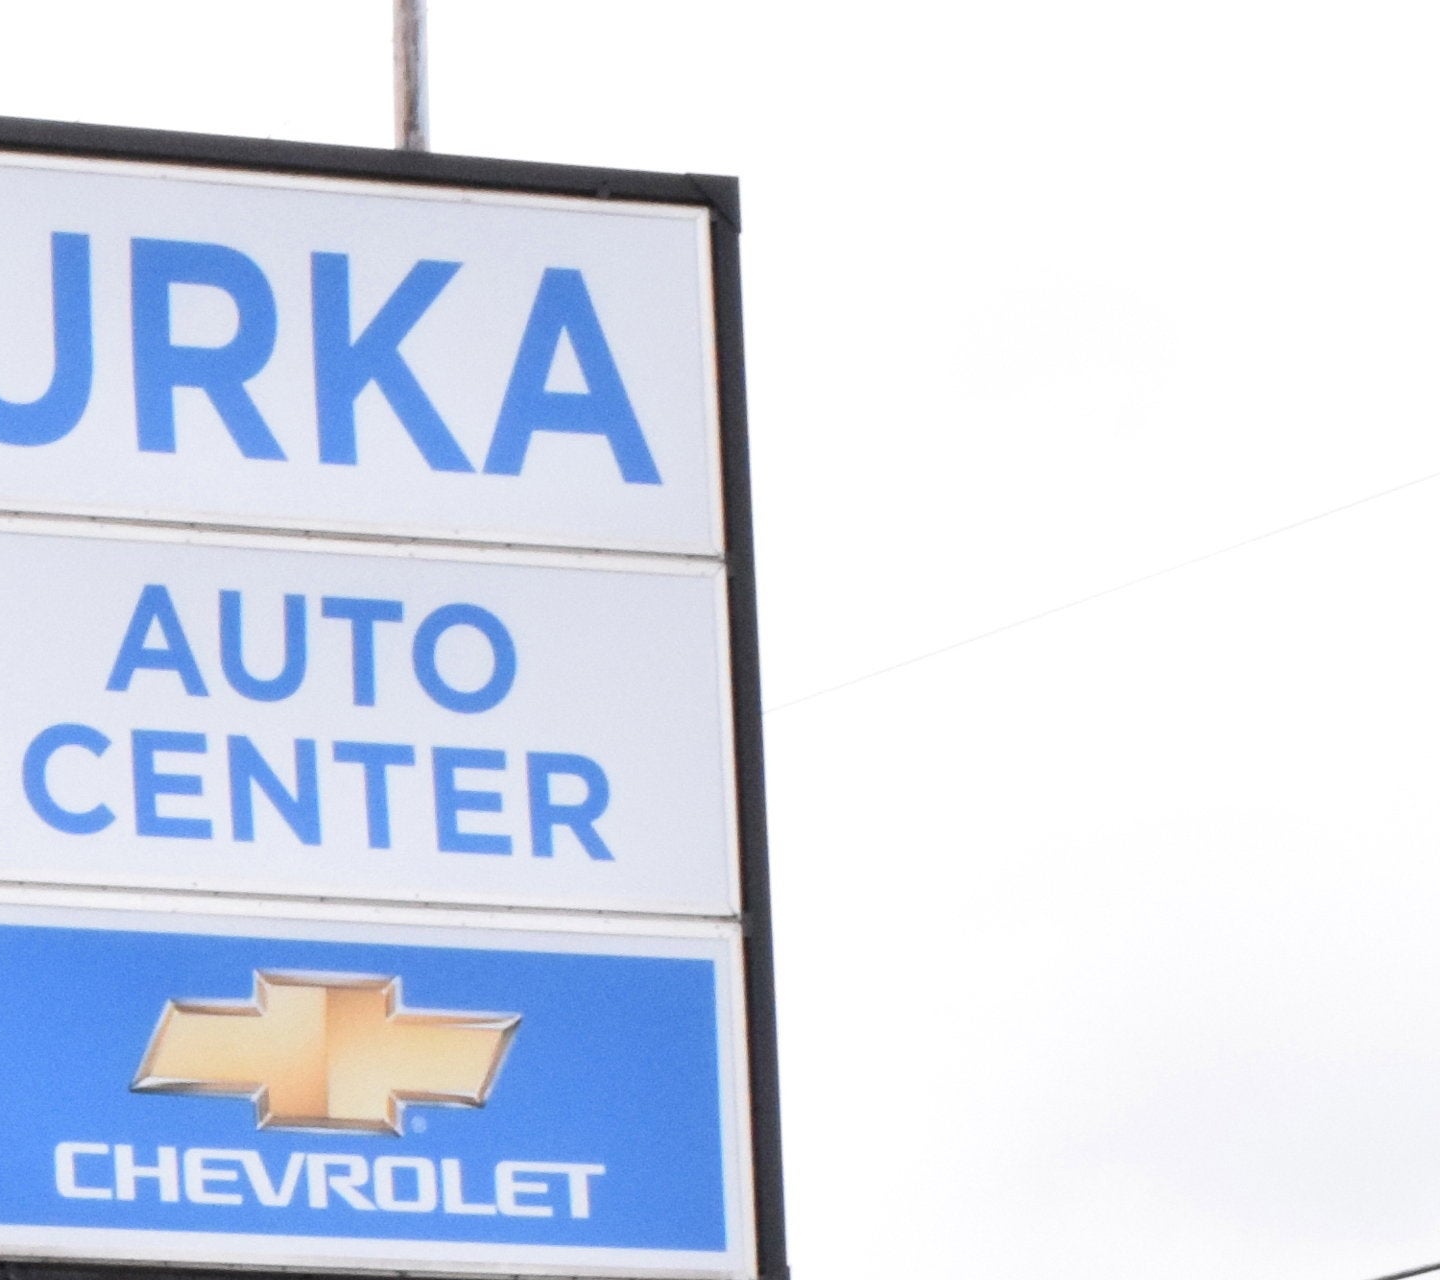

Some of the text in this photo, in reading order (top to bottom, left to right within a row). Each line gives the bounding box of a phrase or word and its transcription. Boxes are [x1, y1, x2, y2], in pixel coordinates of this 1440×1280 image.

[105, 583, 519, 716] AUTO
[21, 722, 616, 862] CENTER
[53, 1141, 606, 1220] CHEVROLET
